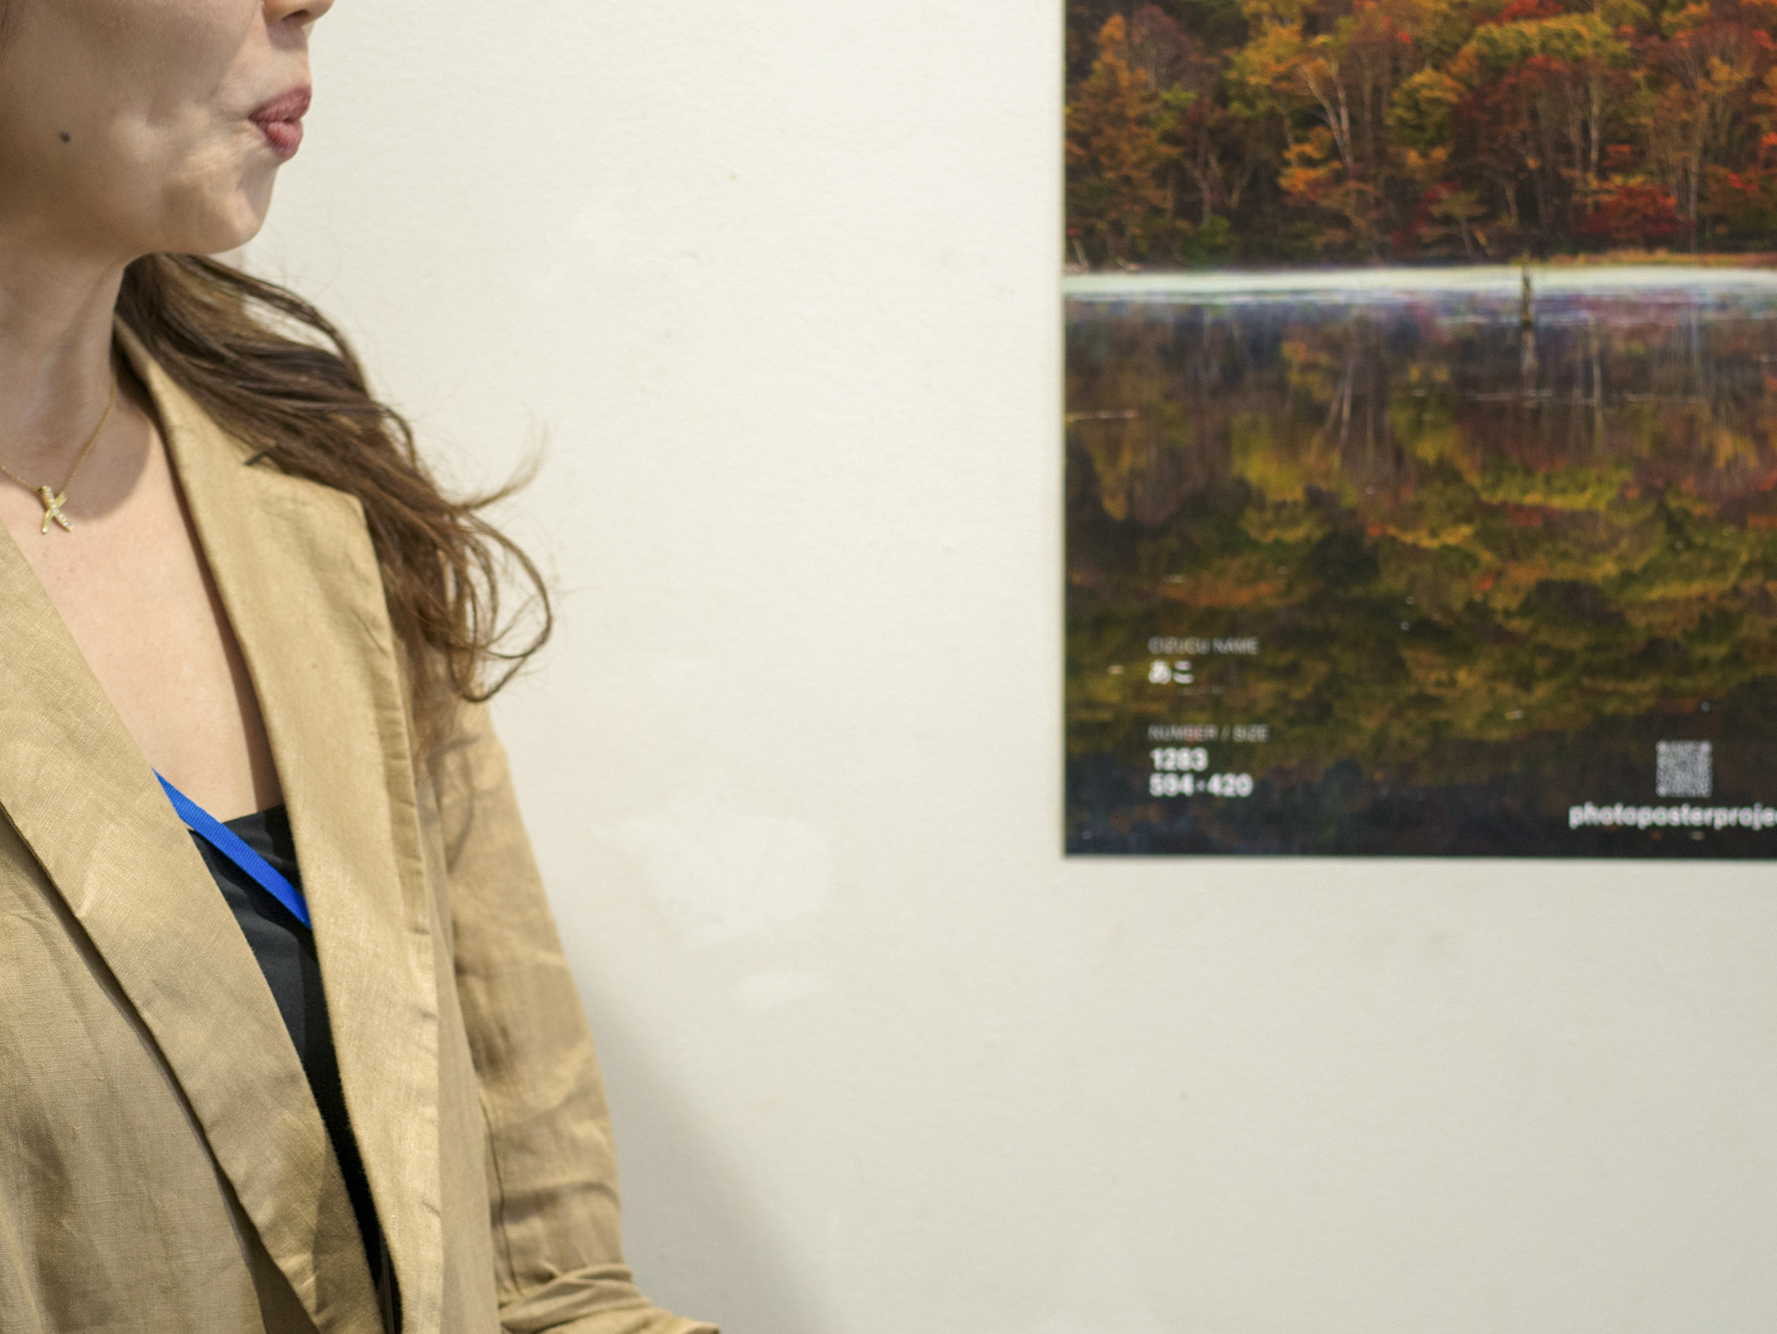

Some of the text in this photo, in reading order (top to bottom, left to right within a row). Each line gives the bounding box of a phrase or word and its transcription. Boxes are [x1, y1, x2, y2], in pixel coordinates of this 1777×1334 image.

[1212, 637, 1260, 655] NAME
[1148, 659, 1195, 684] あこ
[1148, 724, 1219, 742] NUMBER
[1232, 724, 1269, 742] SIZE
